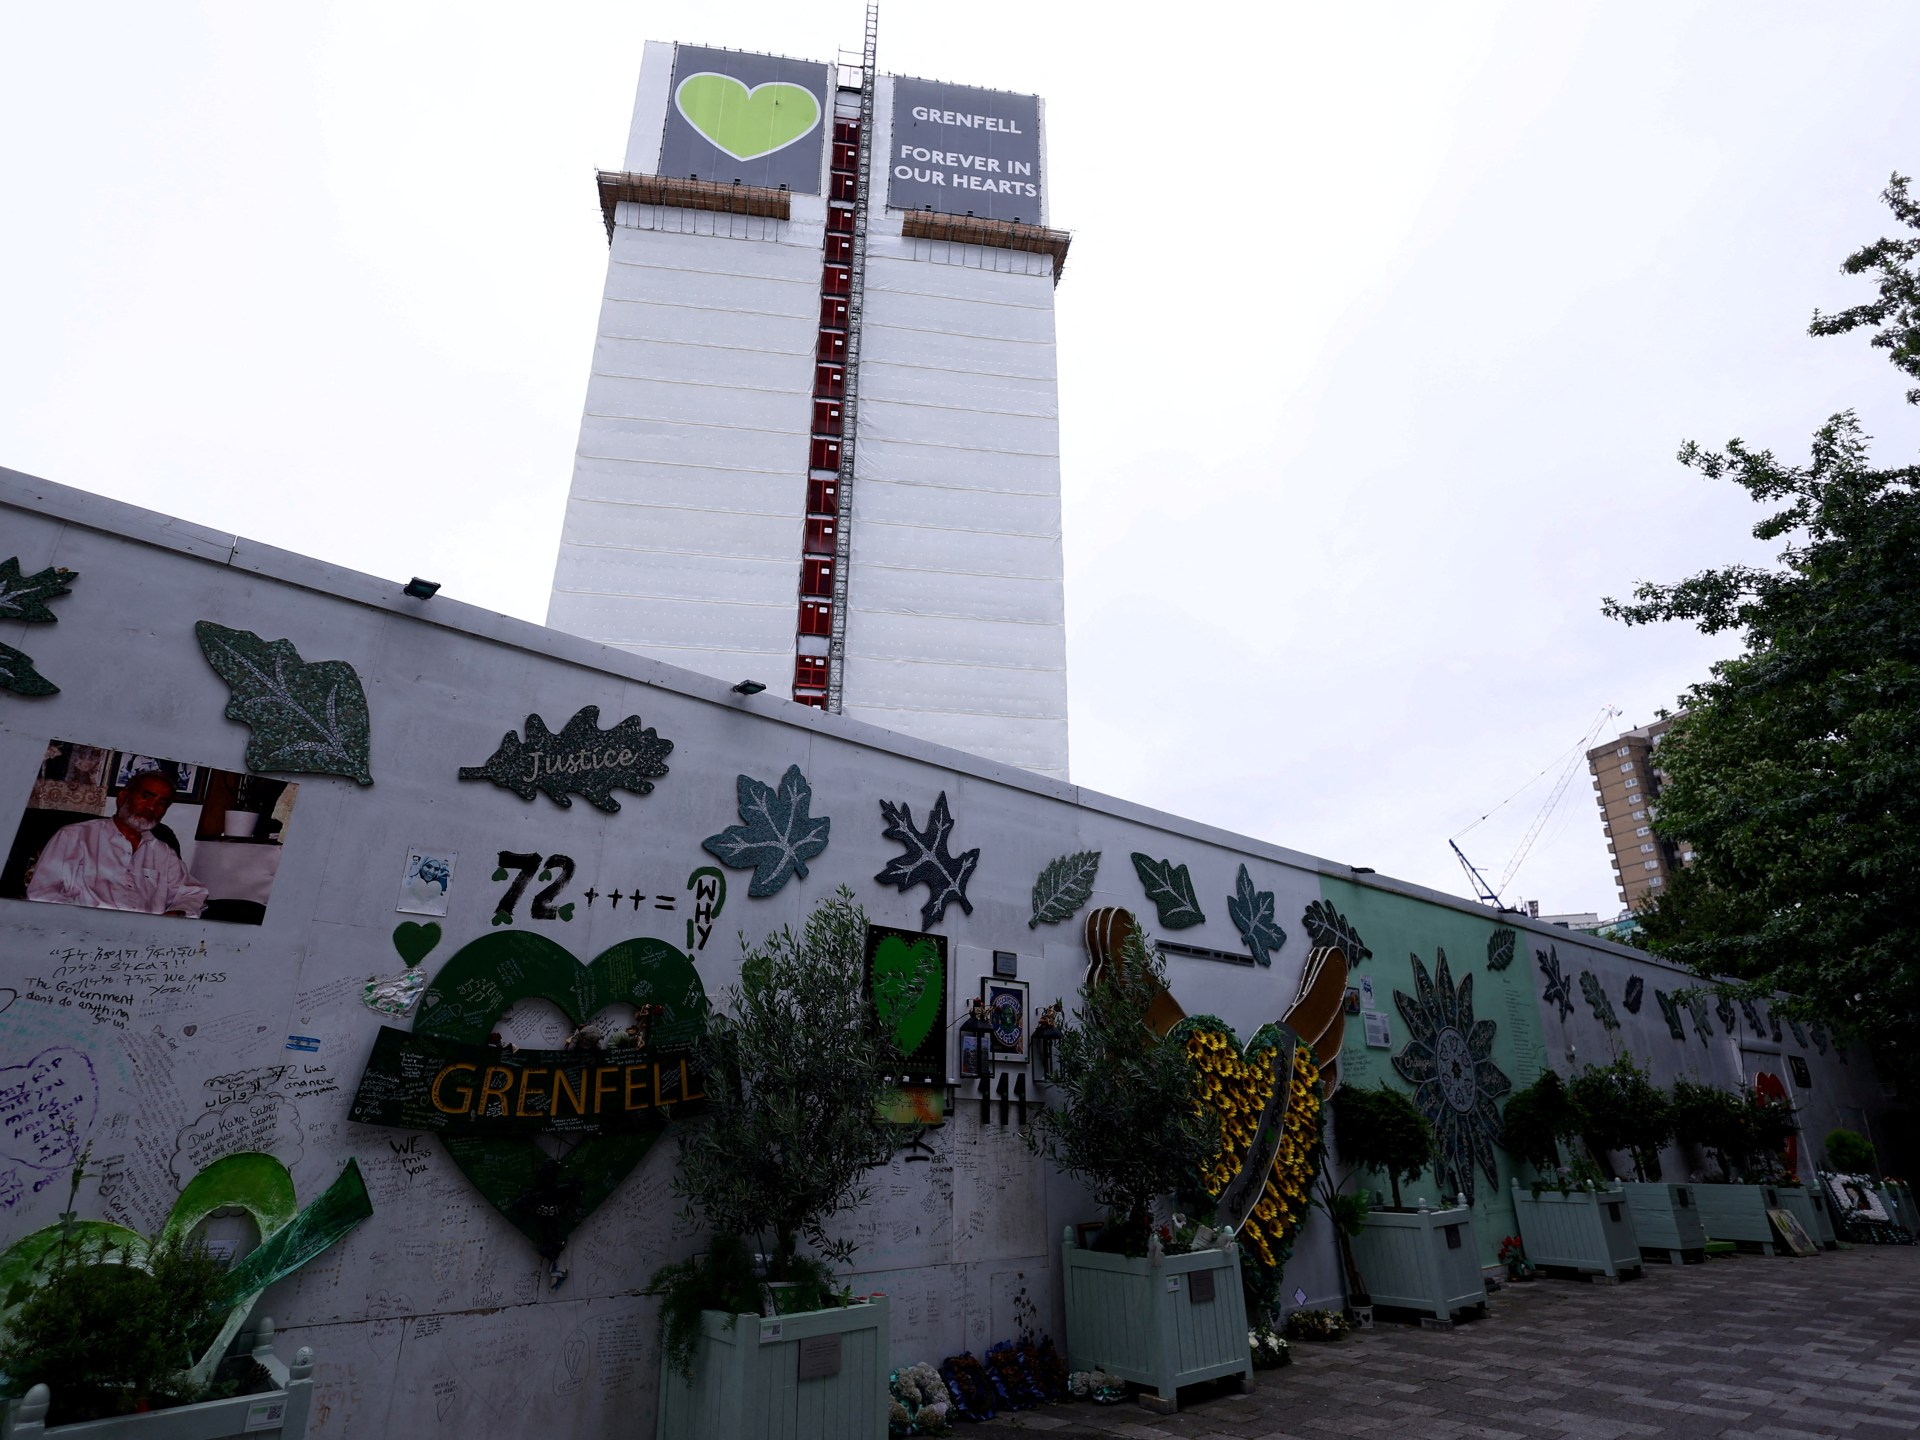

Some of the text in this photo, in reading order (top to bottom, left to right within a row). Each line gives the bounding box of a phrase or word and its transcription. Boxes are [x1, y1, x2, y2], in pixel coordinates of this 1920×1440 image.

[912, 106, 1022, 135] GRENFELL
[901, 145, 1031, 176] FOREVER IN
[894, 164, 1038, 198] OUR HEARTS
[523, 745, 640, 783] Justice
[497, 850, 577, 921] 72
[693, 878, 718, 951] WHY
[25, 977, 51, 990] The
[56, 981, 134, 1006] Government
[26, 991, 130, 1021] don't do anything
[995, 1025, 1021, 1045] LEGEND
[430, 1057, 706, 1118] GRENFELL
[187, 1127, 217, 1150] Dear
[218, 1112, 248, 1133] Kaka
[193, 1154, 212, 1167] and
[251, 1122, 278, 1137] believe
[202, 1140, 215, 1153] all
[235, 1124, 250, 1140] you
[252, 1113, 279, 1127] dearly
[388, 1134, 423, 1155] WE
[402, 1148, 432, 1169] miss
[406, 1163, 429, 1182] you
